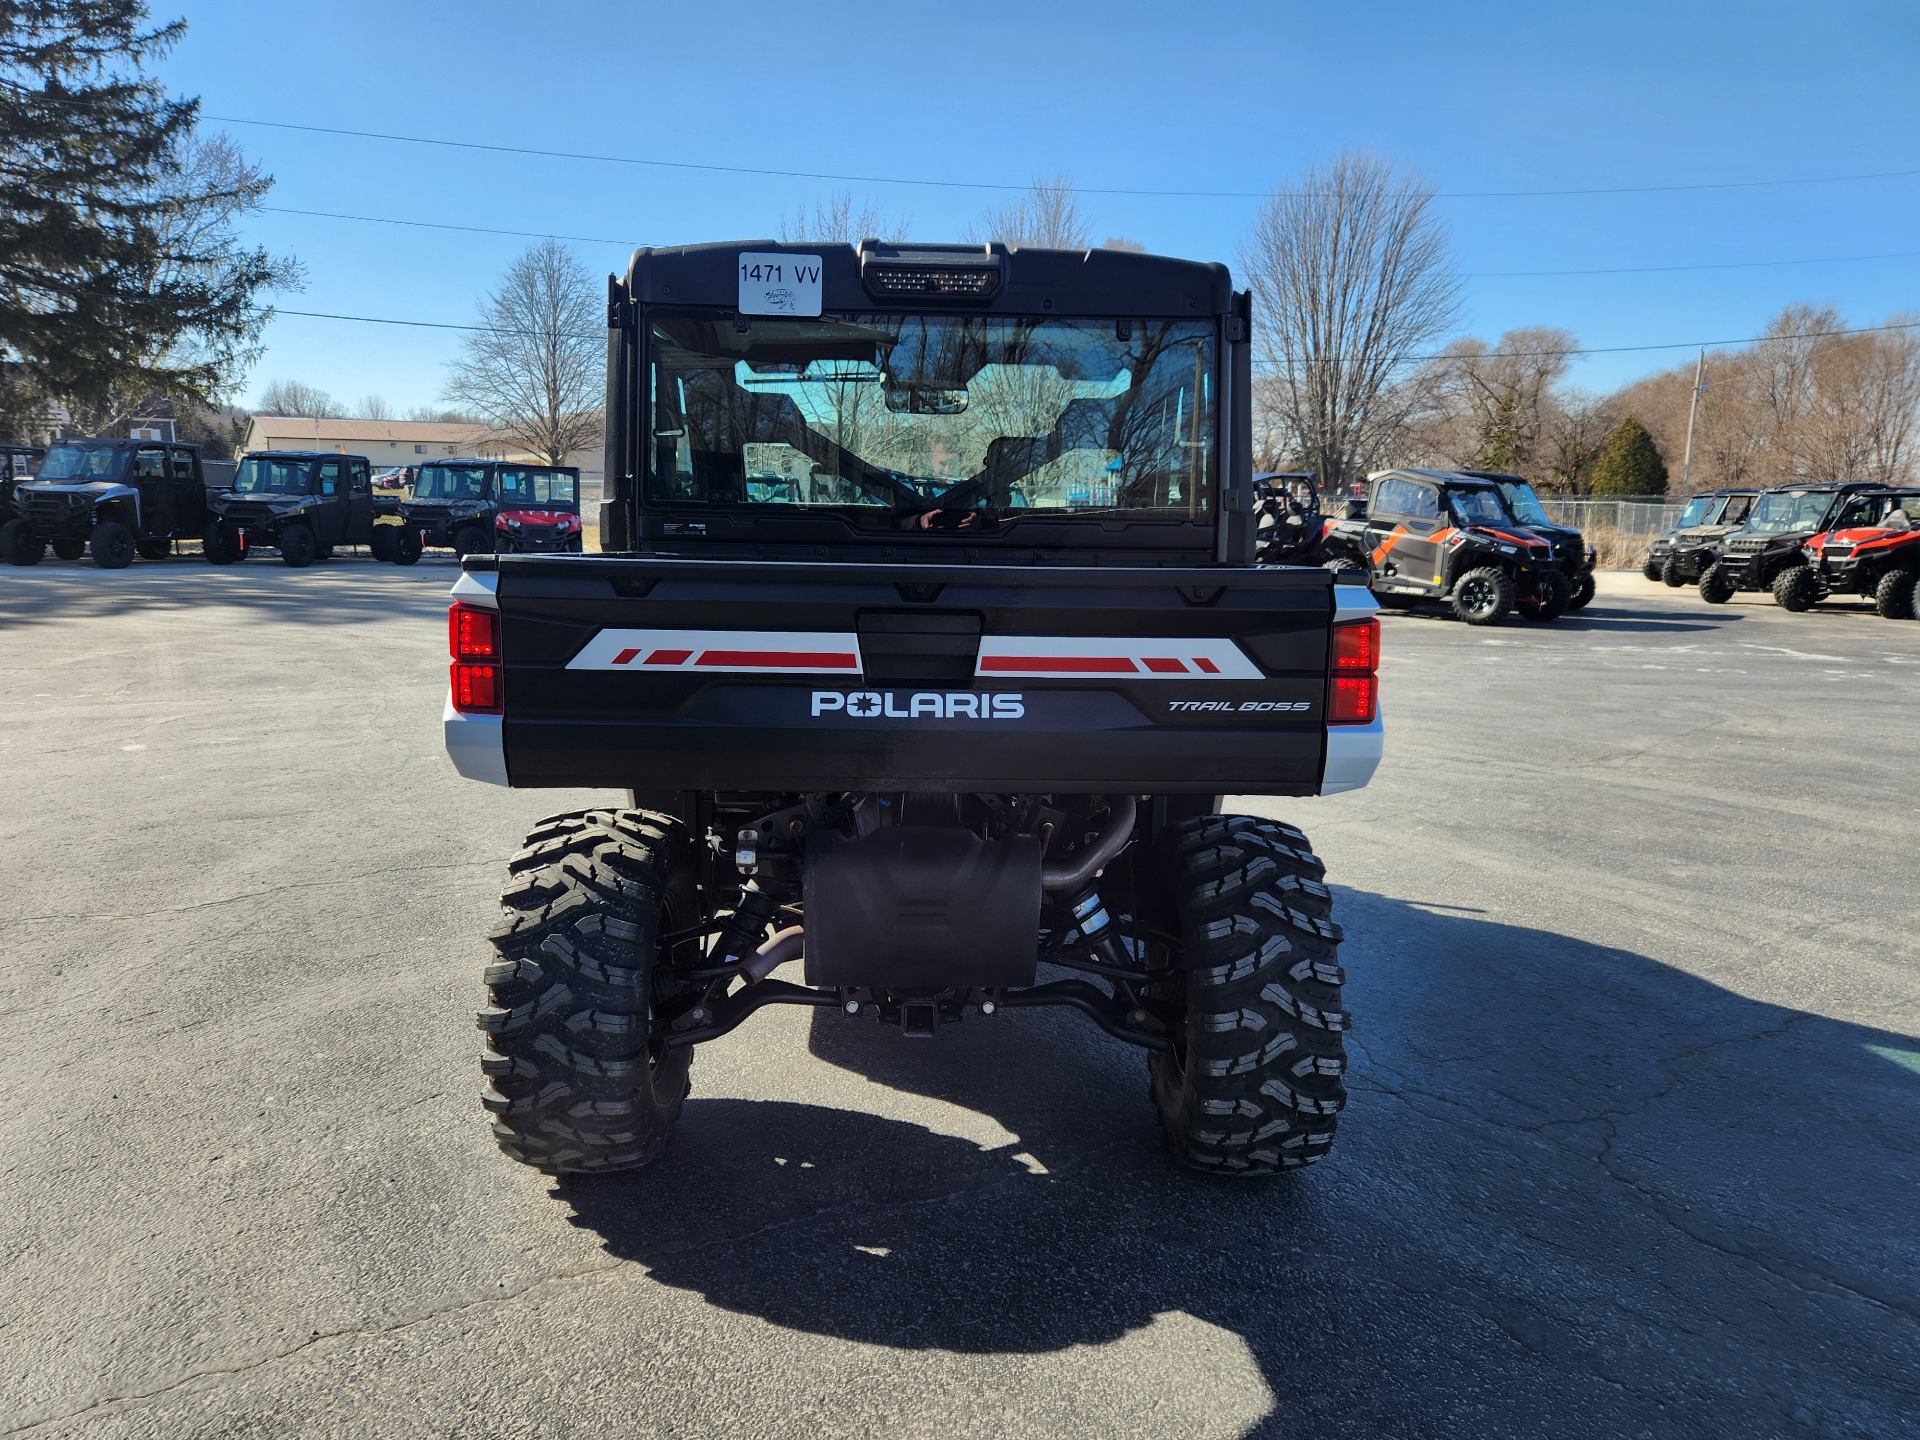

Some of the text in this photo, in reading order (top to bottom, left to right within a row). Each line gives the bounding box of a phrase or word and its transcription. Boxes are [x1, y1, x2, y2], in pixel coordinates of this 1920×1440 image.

[741, 263, 820, 284] 1471 VV
[811, 691, 1025, 719] POLARIS
[1168, 701, 1311, 711] TRAIL BOSS
